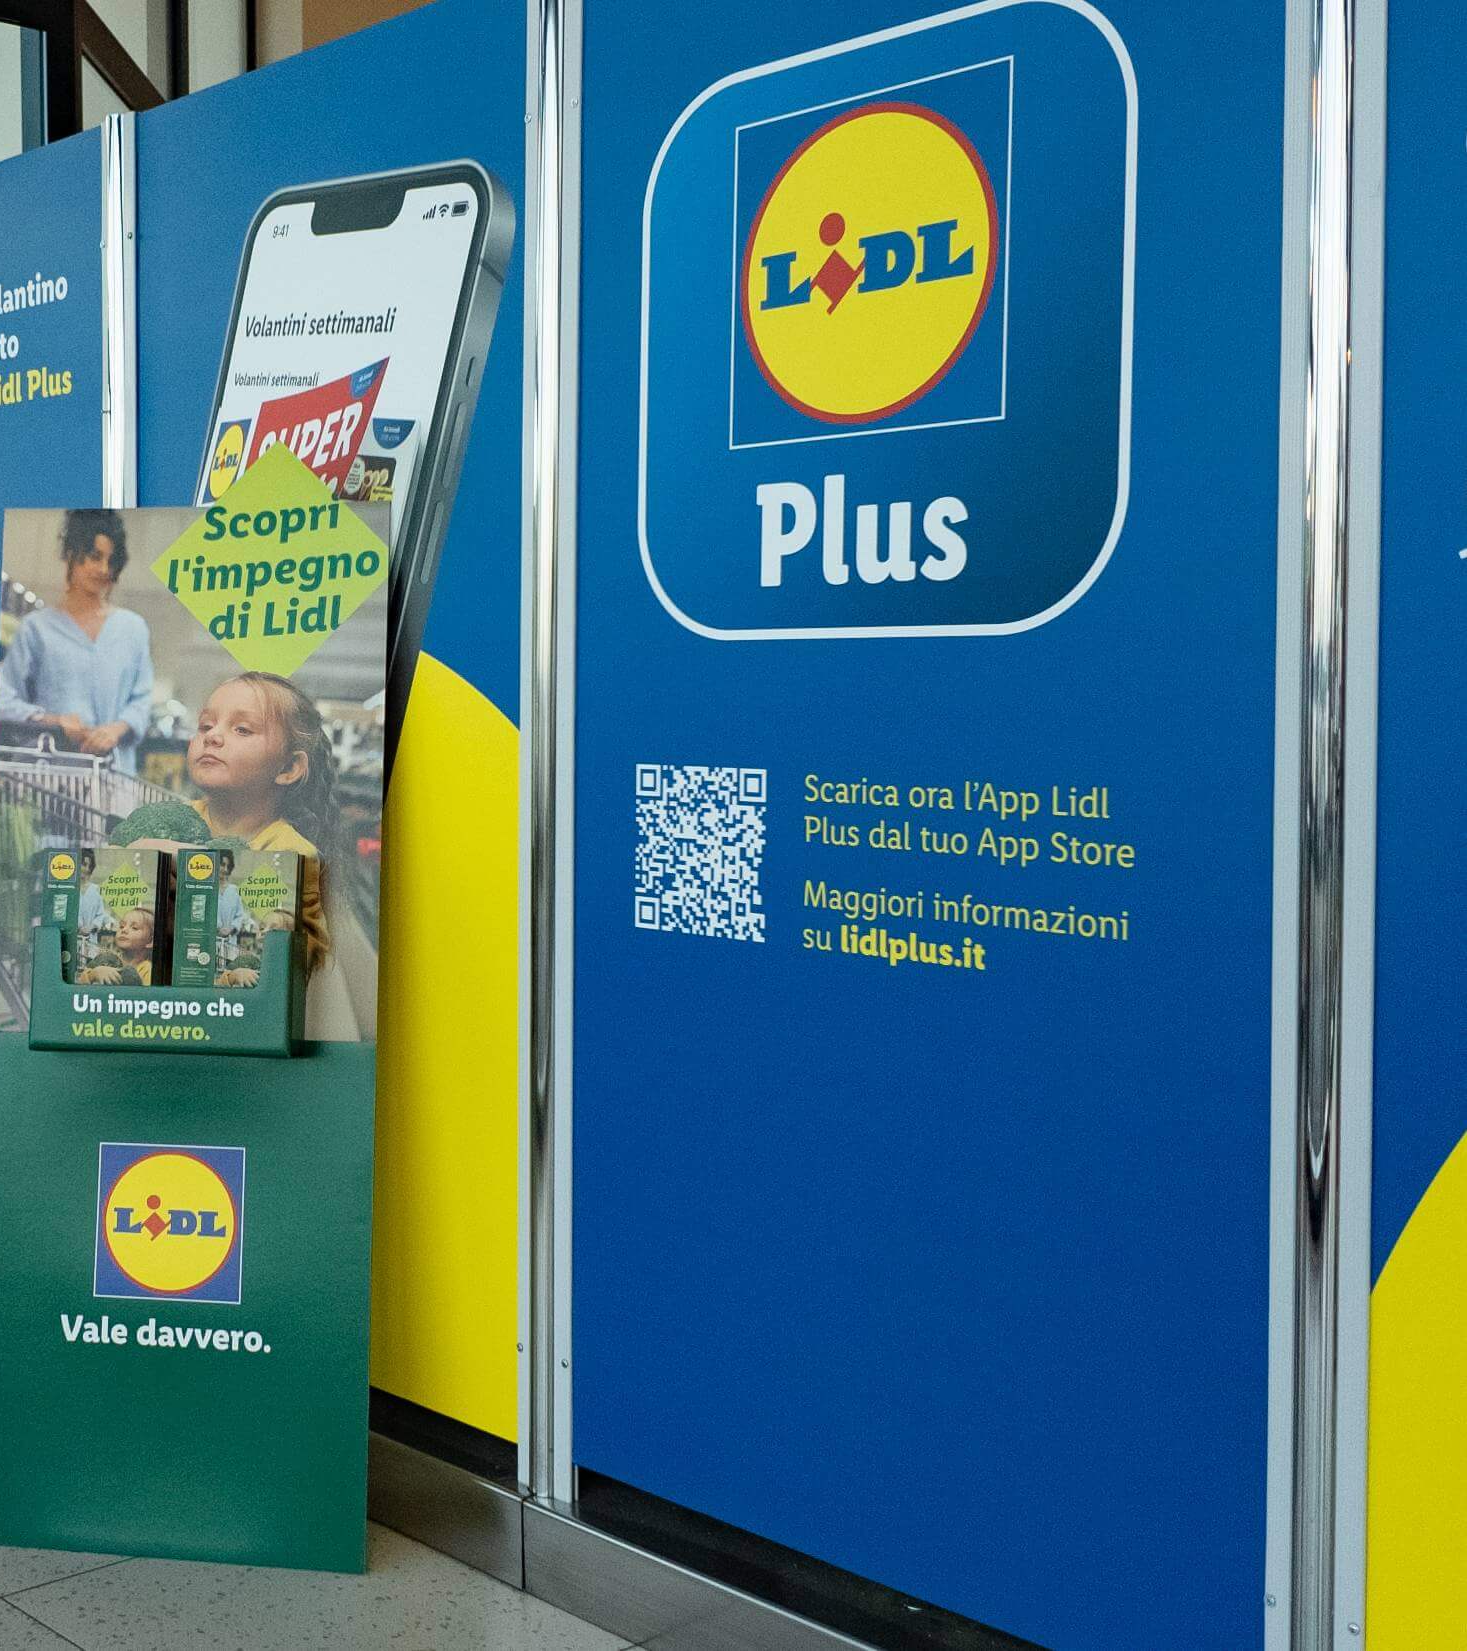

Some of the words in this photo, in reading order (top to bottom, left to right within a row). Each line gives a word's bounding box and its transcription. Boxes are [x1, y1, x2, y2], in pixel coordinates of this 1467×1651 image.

[273, 224, 289, 238] 9:41
[760, 212, 974, 315] LIDL
[245, 312, 308, 338] Volantini
[308, 307, 397, 336] settimanali
[27, 368, 73, 401] Plus
[234, 373, 270, 388] Volantini
[271, 371, 320, 388] settimanali
[203, 493, 340, 544] Scopri
[756, 474, 969, 587] Plus
[168, 550, 380, 597] l'impegno
[209, 601, 251, 641] di
[263, 595, 342, 637] Lidl
[804, 775, 900, 807] Scarica
[908, 783, 955, 810] ora
[964, 781, 1040, 820] l'App
[1051, 786, 1111, 819] Lidl
[804, 816, 860, 847] Plus
[869, 821, 912, 851] dal
[920, 827, 969, 855] tuo
[977, 828, 1040, 867] App
[1050, 832, 1136, 868] Store
[99, 886, 148, 898] l'impegno
[108, 873, 140, 885] Scopri
[238, 887, 288, 899] l'impegno
[247, 874, 279, 886] Scopri
[108, 898, 119, 908] di
[121, 897, 140, 908] Lidl
[247, 899, 259, 909] di
[260, 897, 279, 909] Lidl
[803, 880, 924, 921] Maggiori
[933, 893, 1130, 941] informazioni
[803, 927, 832, 951] su
[840, 925, 986, 970] lidlplus.it
[72, 994, 102, 1013] Un
[108, 994, 201, 1019] impegno
[206, 997, 245, 1018] che
[72, 1018, 115, 1038] vale
[120, 1020, 211, 1041] davvero.
[113, 1195, 226, 1241] LIDL
[61, 1314, 128, 1345] Vale
[136, 1318, 271, 1354] davvero.
